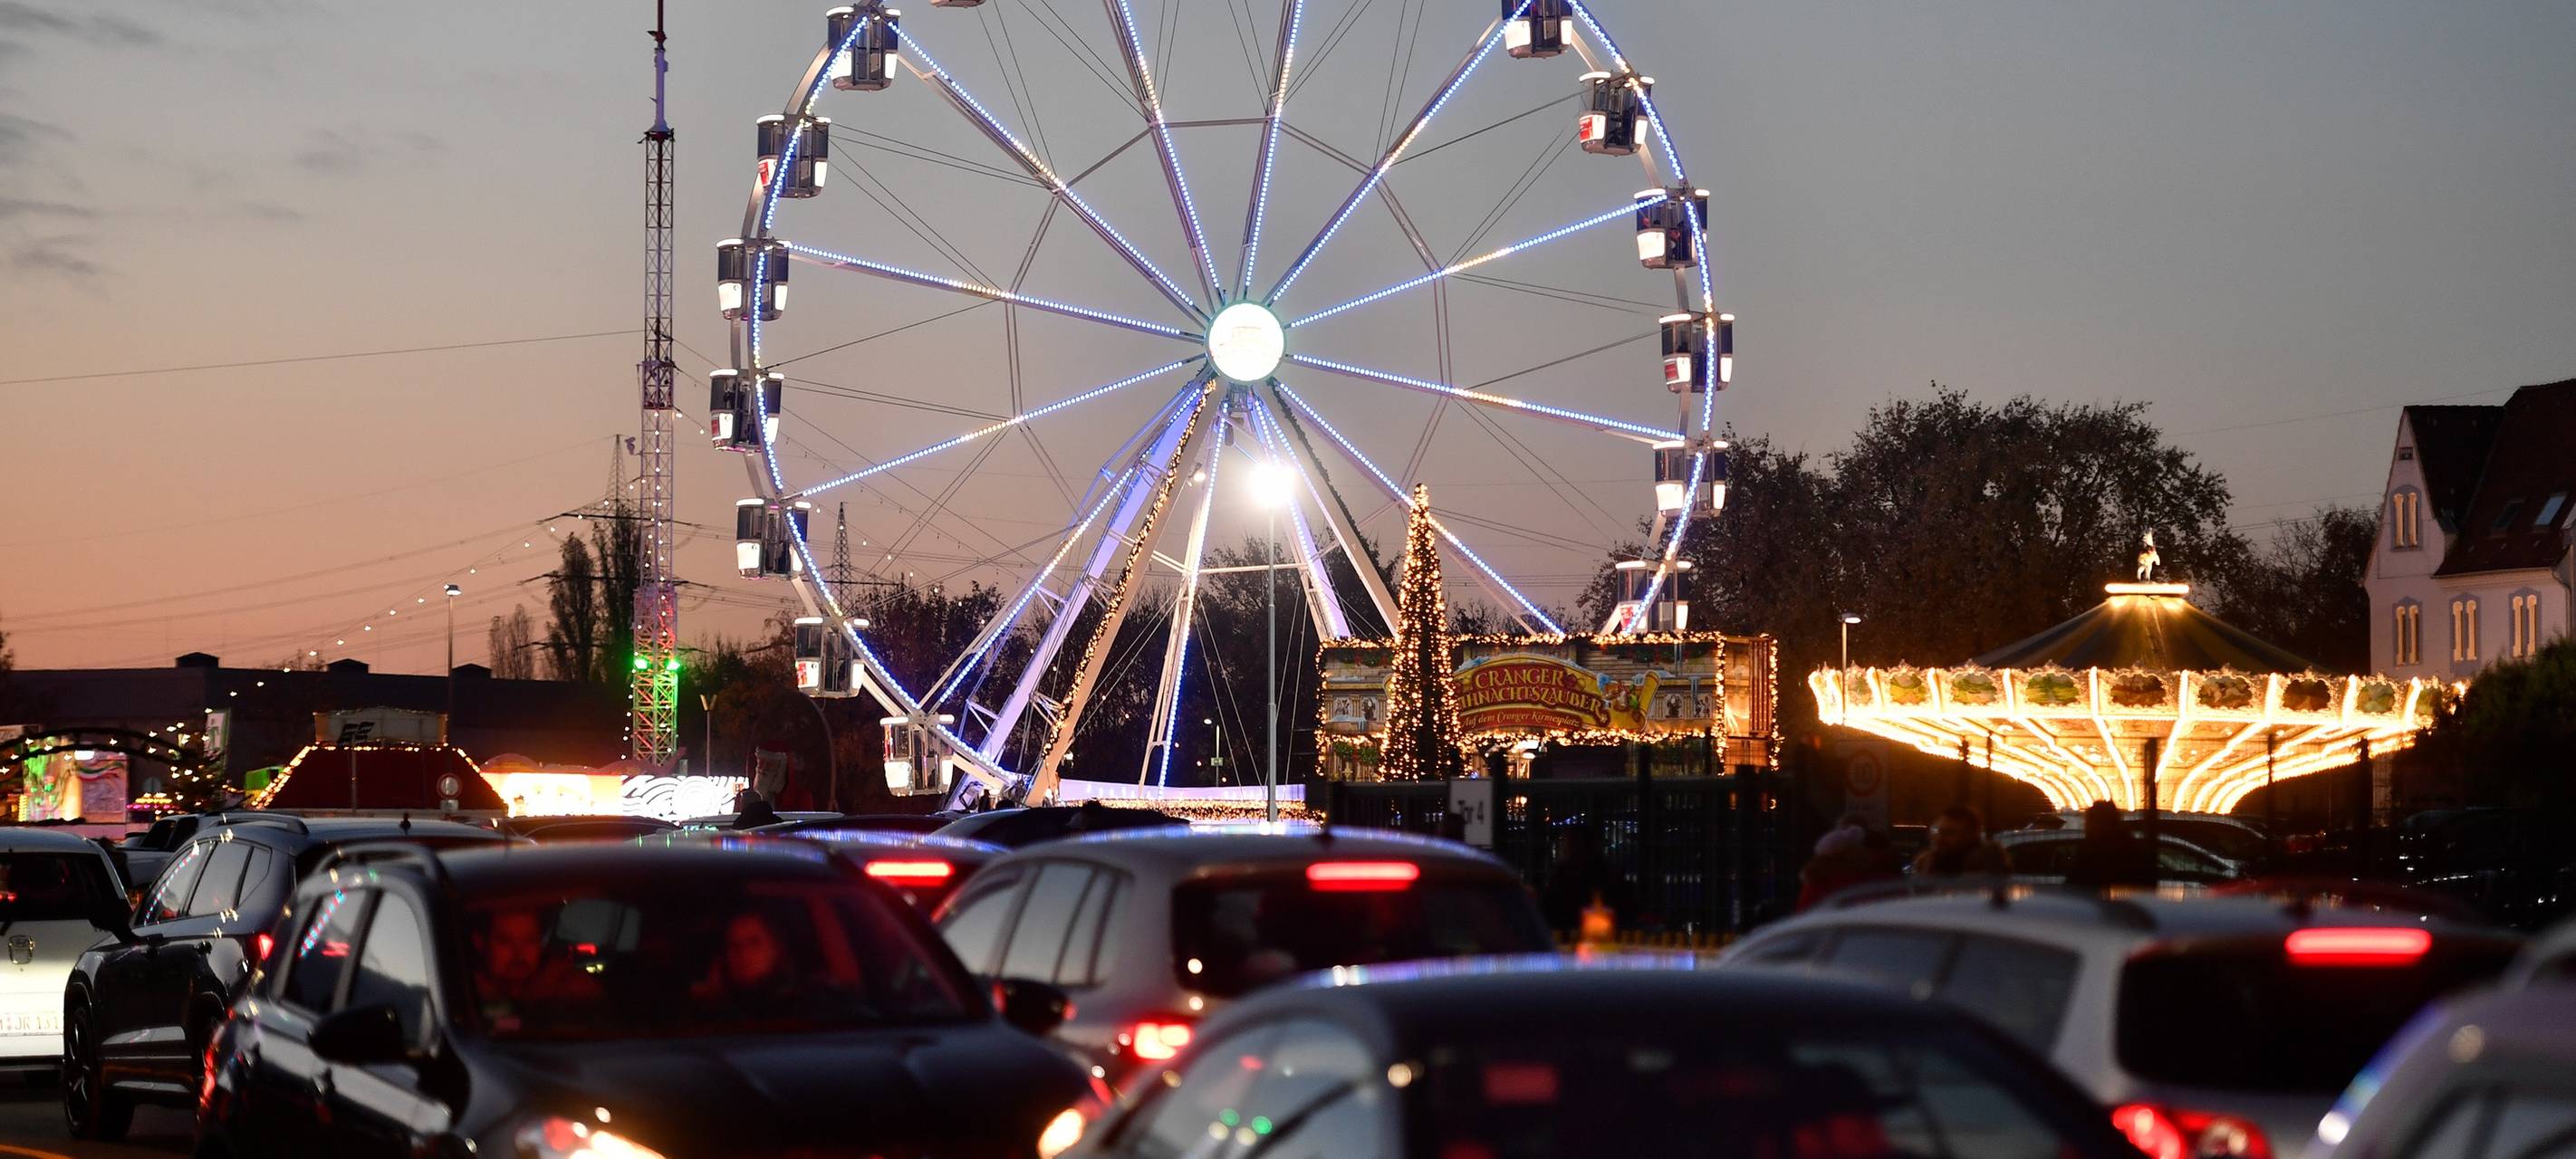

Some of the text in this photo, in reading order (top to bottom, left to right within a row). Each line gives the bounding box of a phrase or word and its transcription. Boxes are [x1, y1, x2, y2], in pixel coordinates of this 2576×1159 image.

[1475, 668, 1565, 689] CRANGER
[1457, 685, 1607, 718] IHNACHTSZAUBER
[1478, 714, 1495, 724] dem
[1497, 711, 1529, 724] Cranger
[1532, 711, 1581, 727] Kirmesplatz
[1476, 800, 1485, 825] 4
